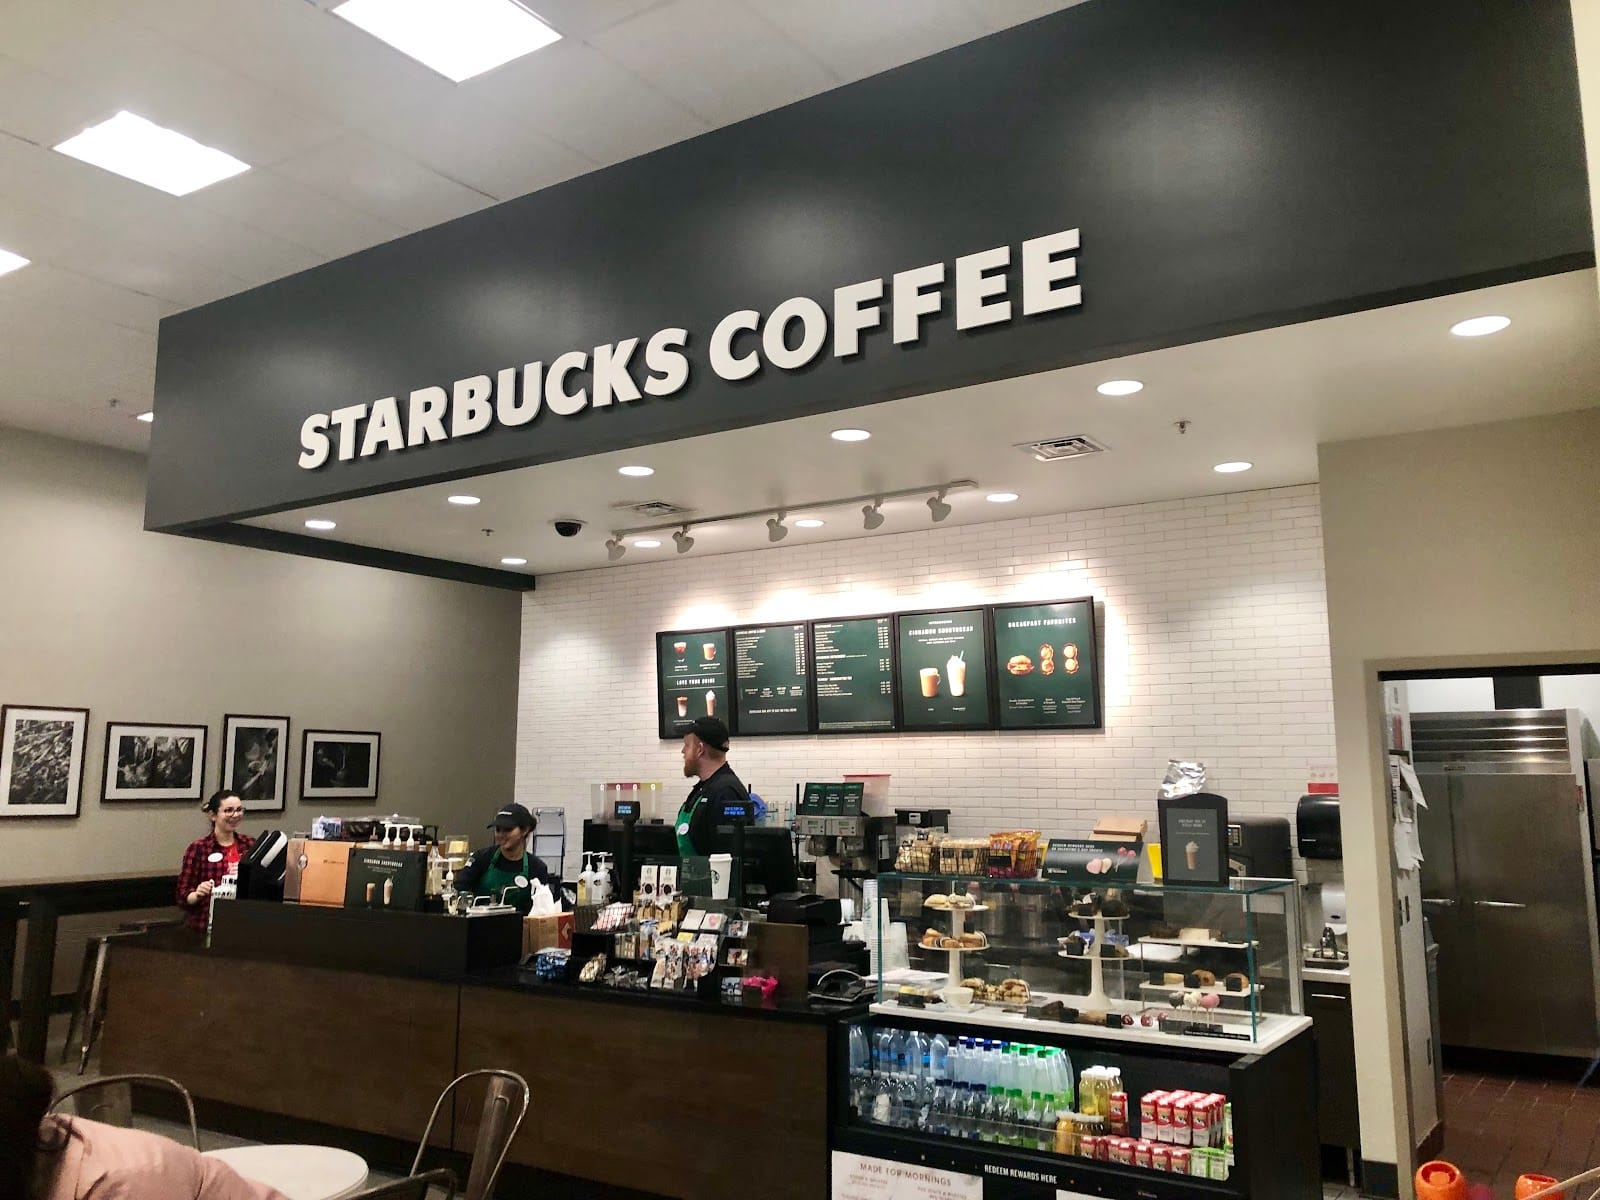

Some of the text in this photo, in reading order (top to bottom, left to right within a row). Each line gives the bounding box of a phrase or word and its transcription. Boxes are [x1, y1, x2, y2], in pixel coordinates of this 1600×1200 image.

[297, 227, 1083, 471] STARBUCKS COFFEE
[908, 628, 937, 636] CINNAMON
[1008, 617, 1077, 628] BREAKFAST FAVORITES
[860, 1162, 951, 1187] MADE FOR MORNINGS
[984, 1164, 1058, 1185] REDEEM REWARDS HERE
